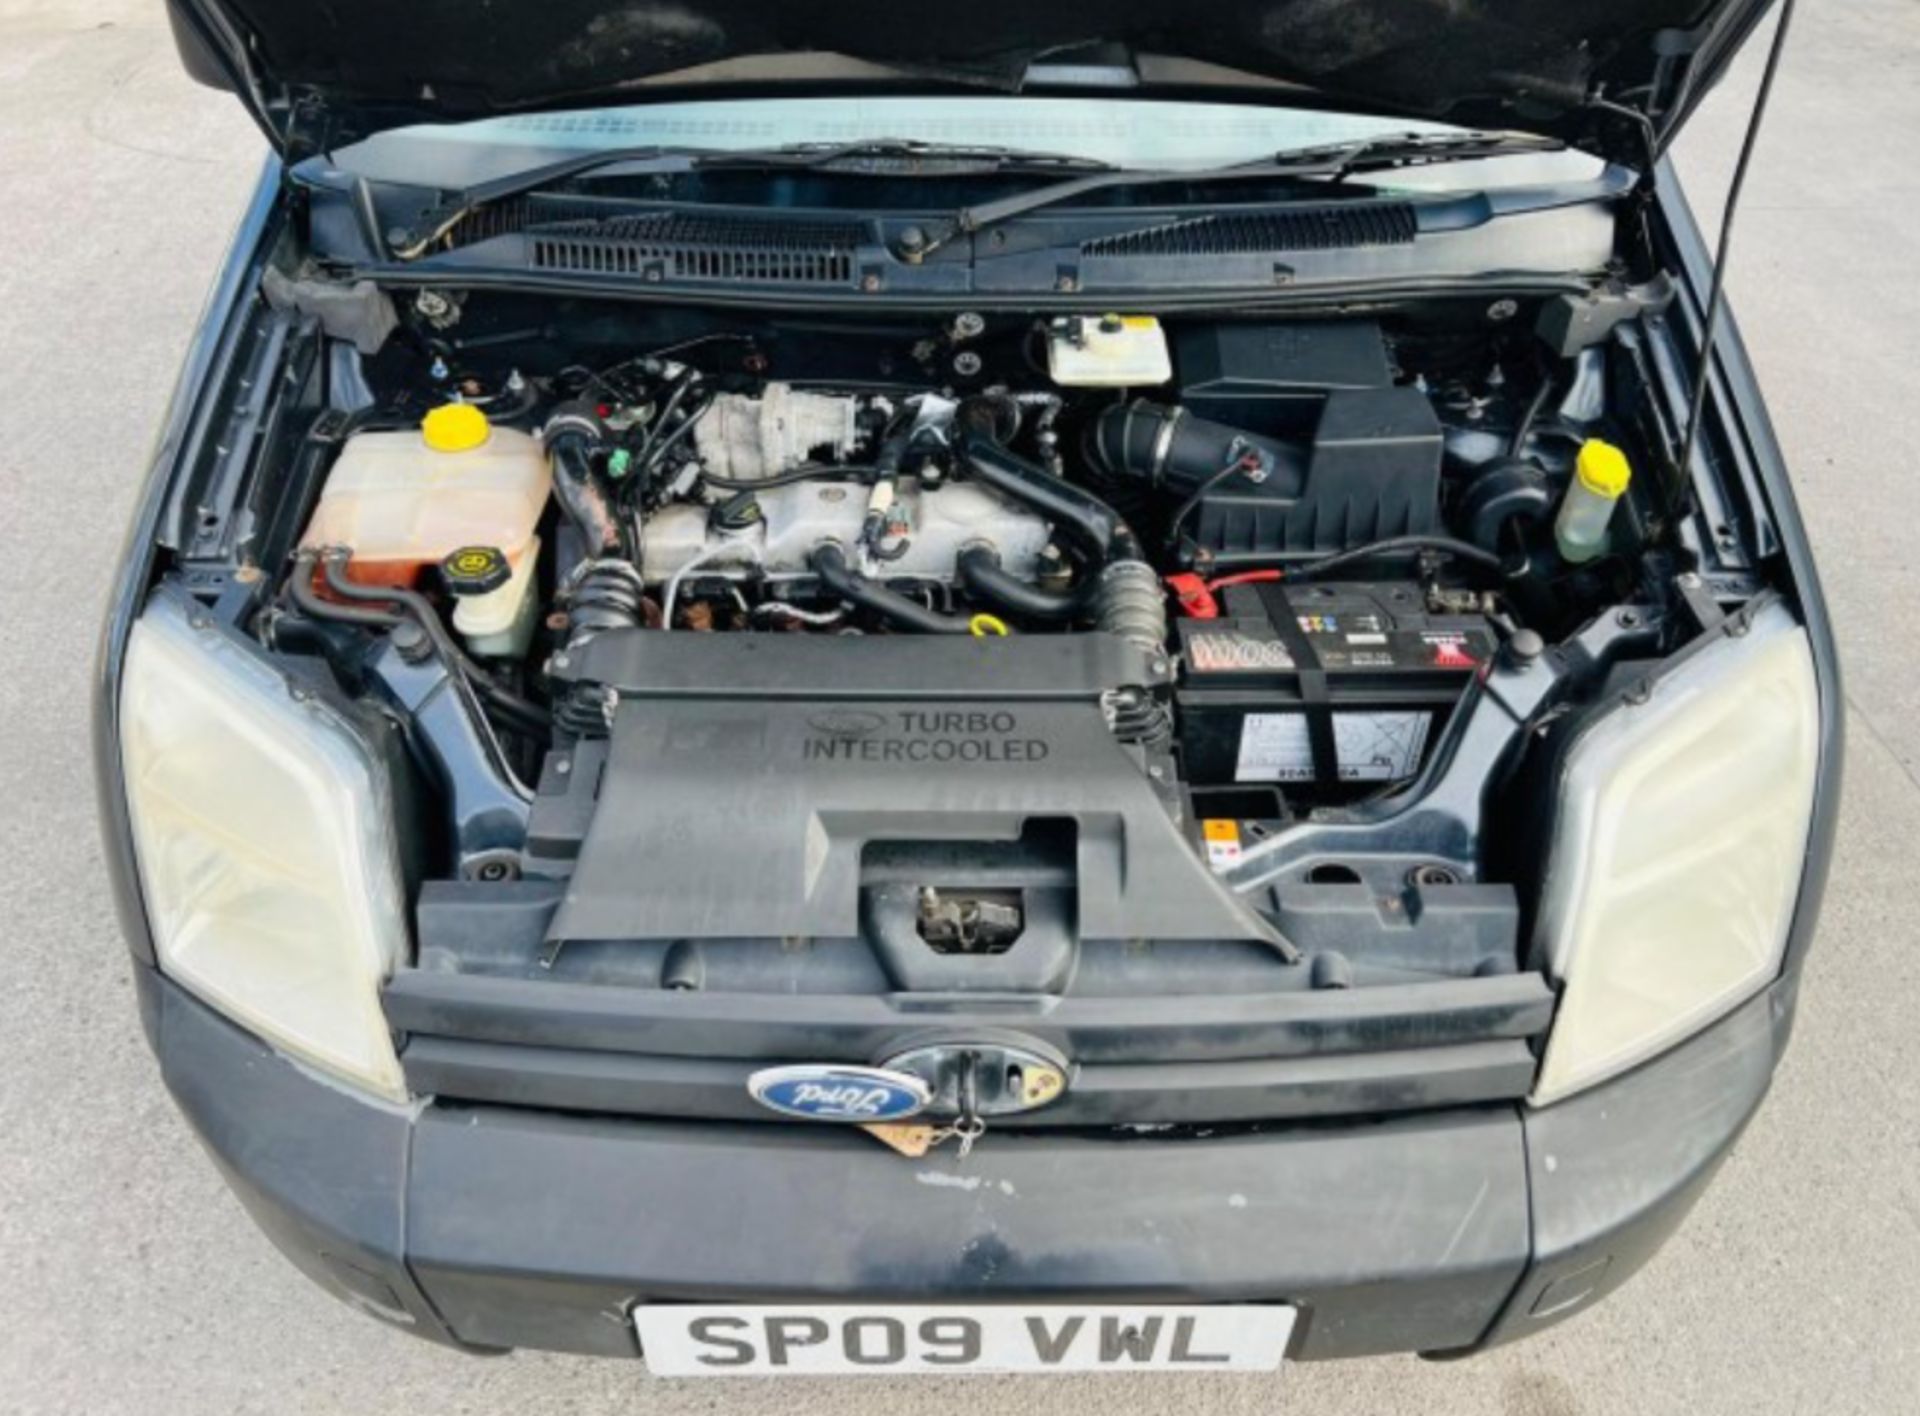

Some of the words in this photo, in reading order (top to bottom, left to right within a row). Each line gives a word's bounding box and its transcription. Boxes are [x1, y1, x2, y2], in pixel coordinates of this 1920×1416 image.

[899, 712, 1016, 733] TURBO
[803, 739, 1049, 761] INTERCOOLED
[791, 1082, 891, 1115] Ford
[688, 1316, 982, 1366] SP09
[1024, 1316, 1230, 1364] VWL
